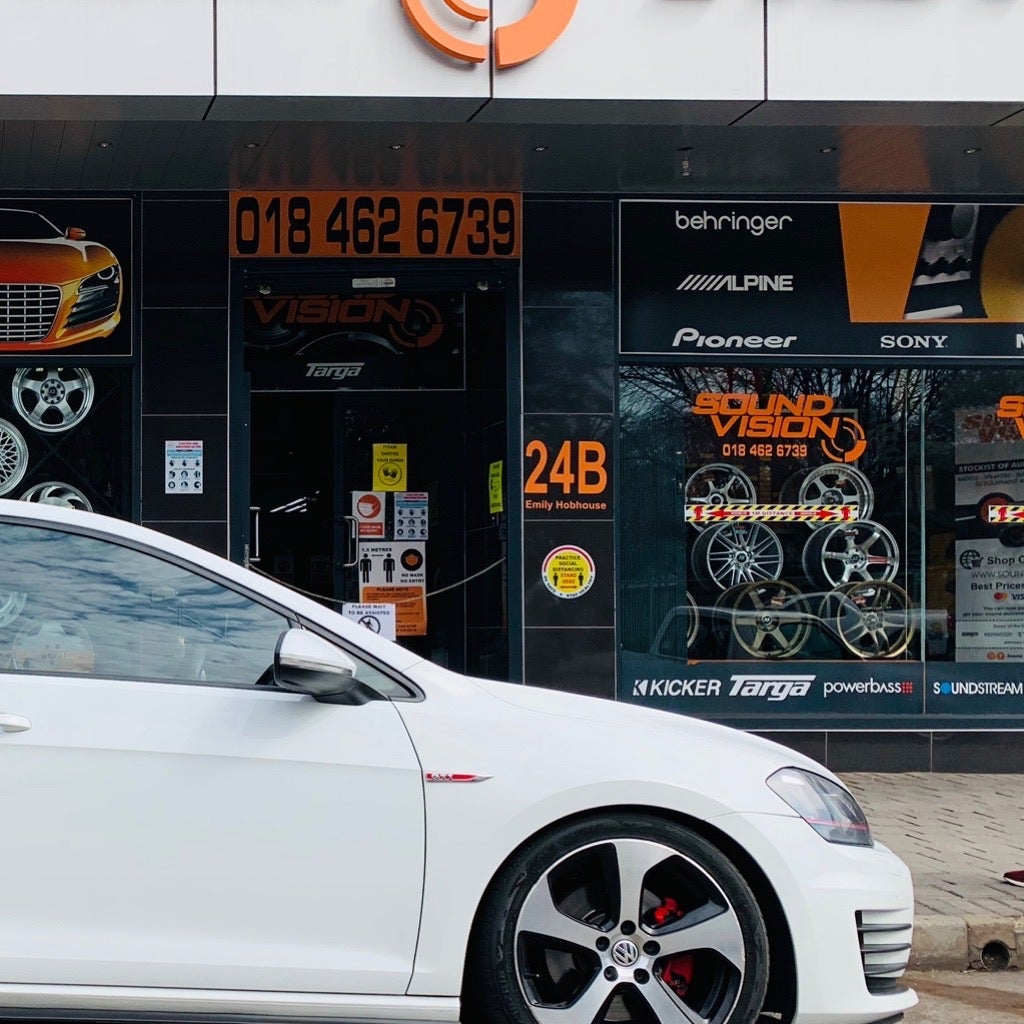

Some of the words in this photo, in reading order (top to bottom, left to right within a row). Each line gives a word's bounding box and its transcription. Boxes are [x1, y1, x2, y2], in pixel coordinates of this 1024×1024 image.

[236, 196, 311, 254] 018
[326, 197, 401, 254] 462
[416, 197, 515, 256] 6739
[676, 210, 792, 236] behringer
[252, 298, 411, 324] VISION
[672, 327, 797, 349] Pioneer
[880, 335, 947, 349] SONY
[305, 362, 365, 380] Targa
[692, 393, 835, 416] SOUND
[711, 415, 840, 438] VISION
[723, 444, 746, 457] 018
[749, 444, 773, 457] 462
[776, 444, 807, 457] 6739
[524, 440, 607, 494] 24B
[525, 500, 553, 511] Emily
[556, 500, 607, 510] Hobhouse
[987, 556, 1015, 566] Shop
[971, 582, 992, 591] Best
[649, 679, 721, 696] KICKER
[729, 674, 817, 702] Targa
[823, 677, 902, 698] powerbass
[933, 683, 1023, 695] SOUNDSTREAM
